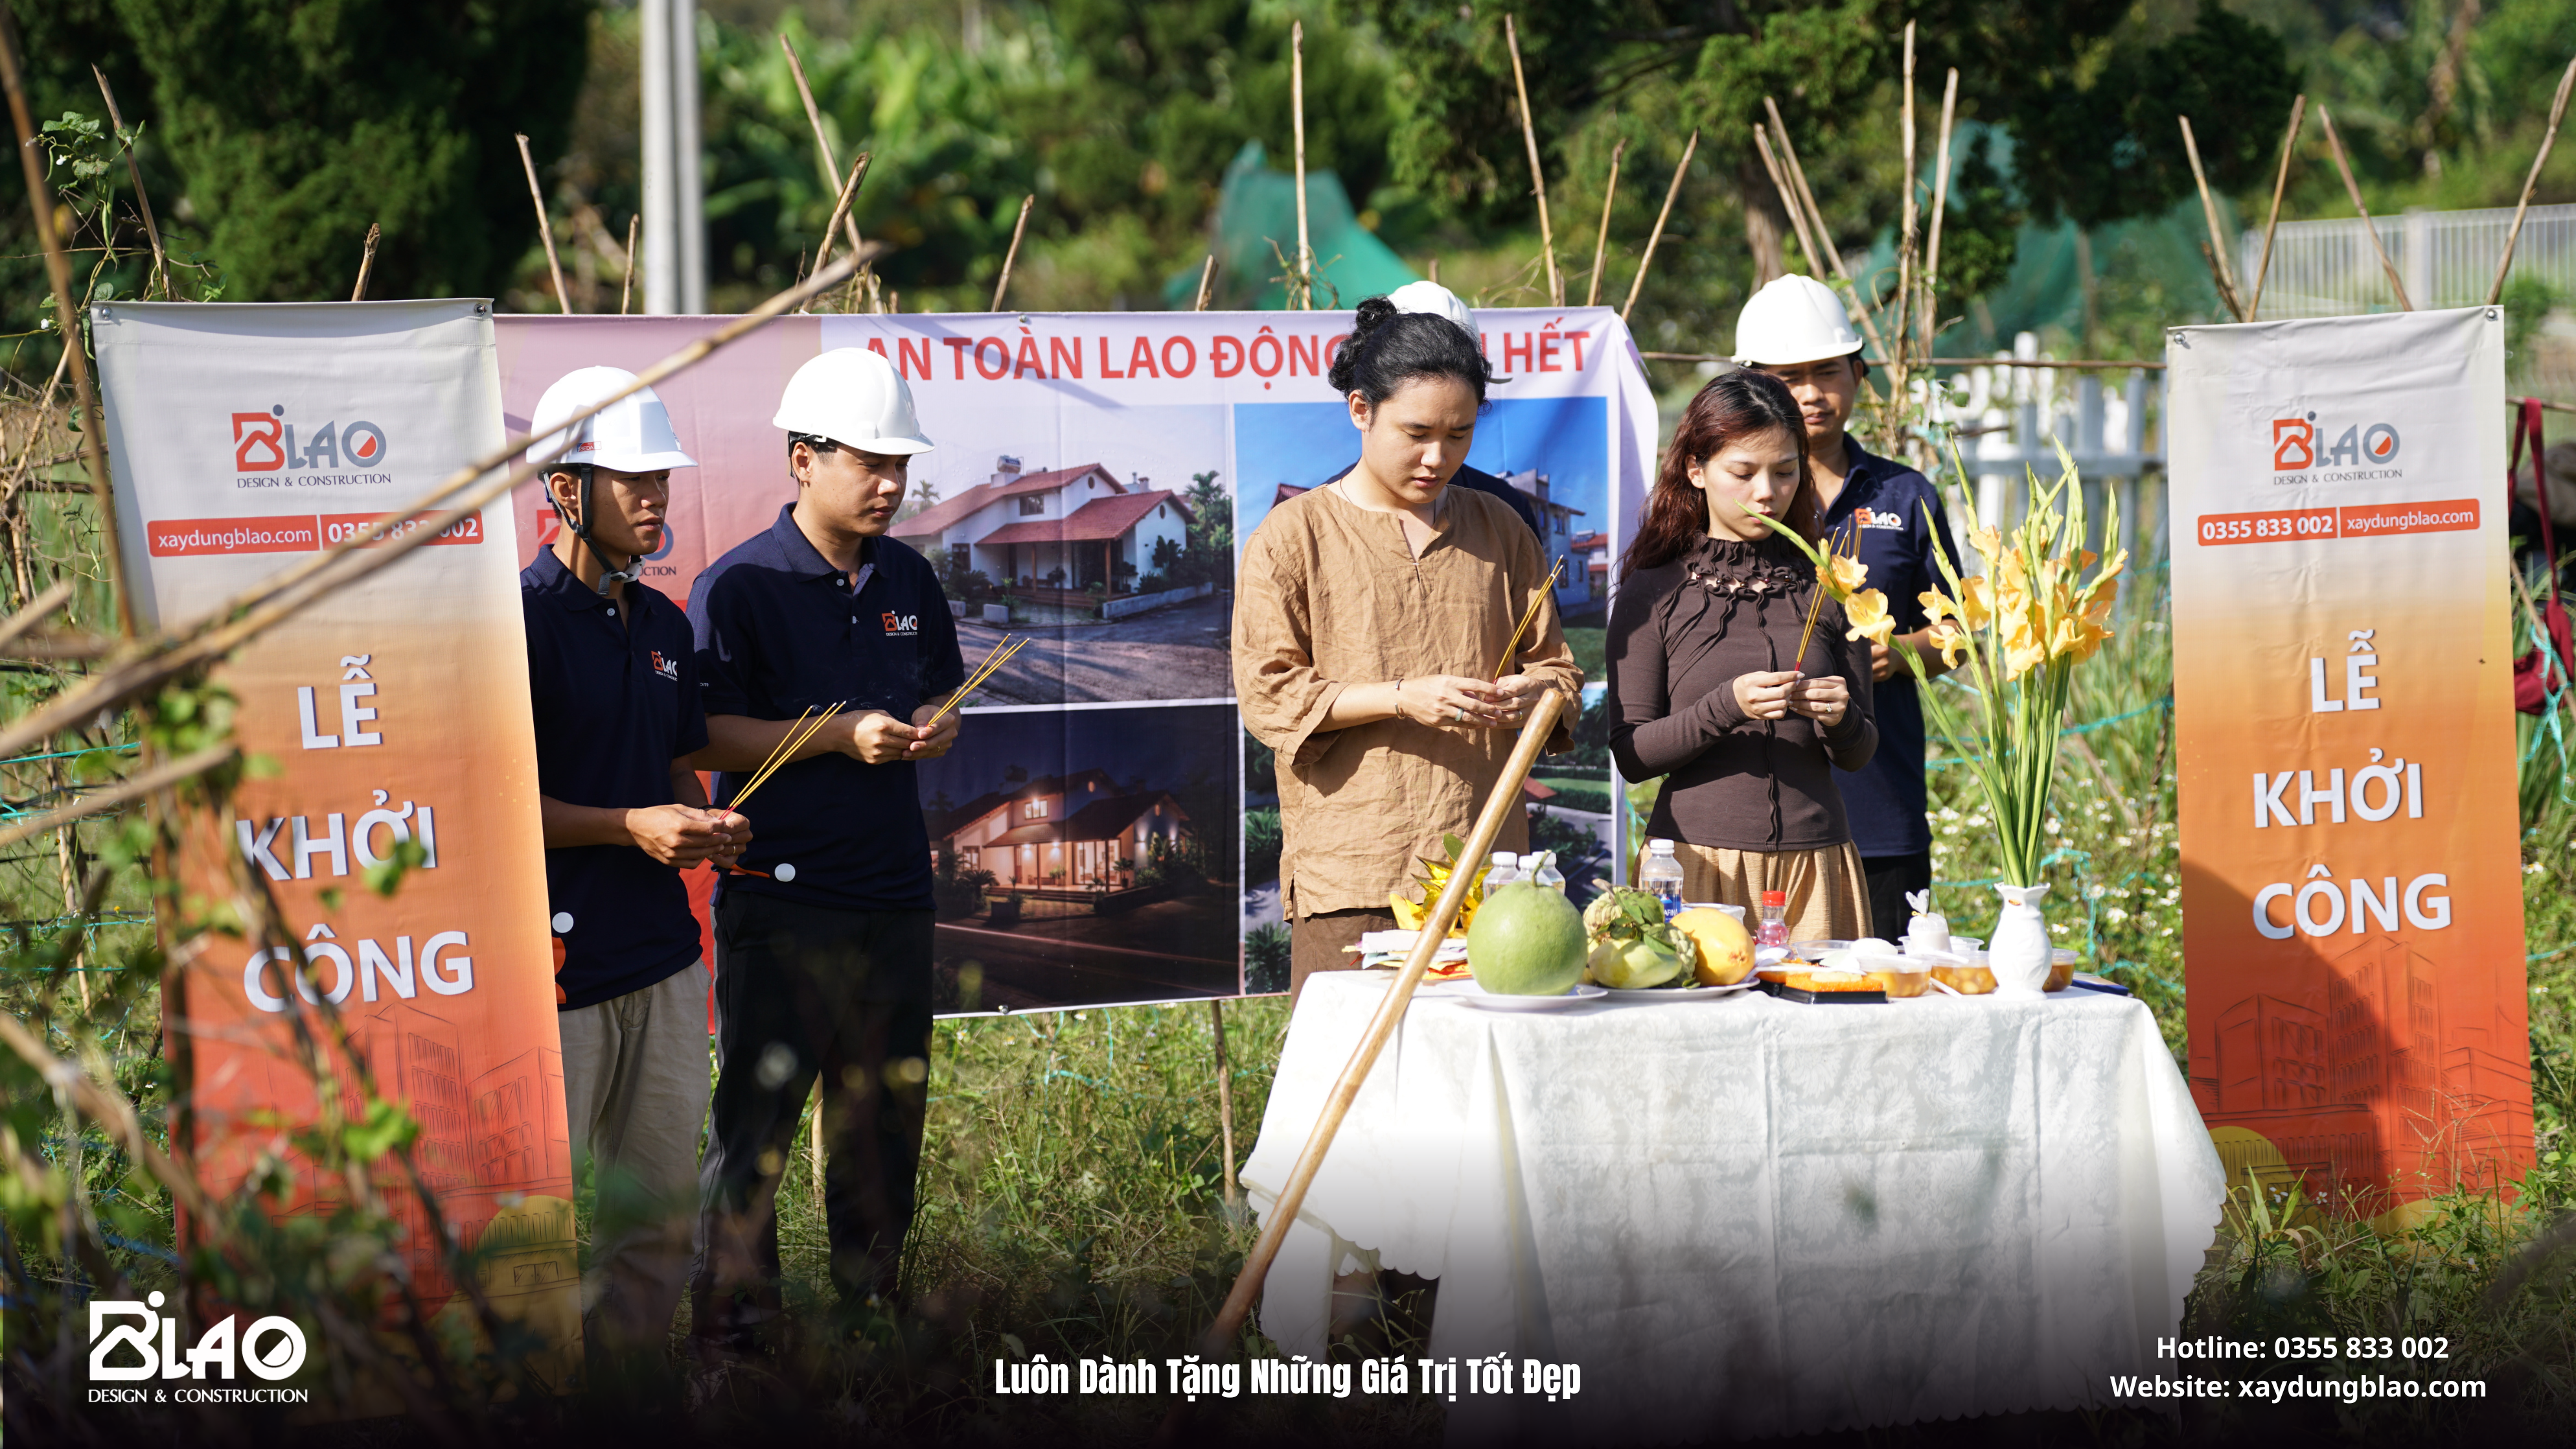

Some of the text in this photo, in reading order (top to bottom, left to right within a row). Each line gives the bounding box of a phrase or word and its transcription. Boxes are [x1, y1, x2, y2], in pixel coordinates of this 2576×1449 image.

[943, 326, 1083, 381] TOÀN
[1099, 336, 1197, 379] LAO
[1504, 317, 1591, 373] HẾT
[237, 473, 391, 488] DESIGN & CONSTRUCTION
[2274, 469, 2402, 485] DESIGN & CONSTRUCTION
[158, 527, 312, 551] xaydungblao.com
[2203, 515, 2333, 540] 0355 833 002
[2347, 509, 2474, 532] xaydungblao.com
[297, 654, 382, 749] LỄ
[2311, 629, 2380, 713] LỄ
[2253, 747, 2422, 828] KHỞI
[236, 789, 437, 881] KHỞI
[2252, 864, 2451, 940] CÔNG
[244, 923, 474, 1012] CÔNG
